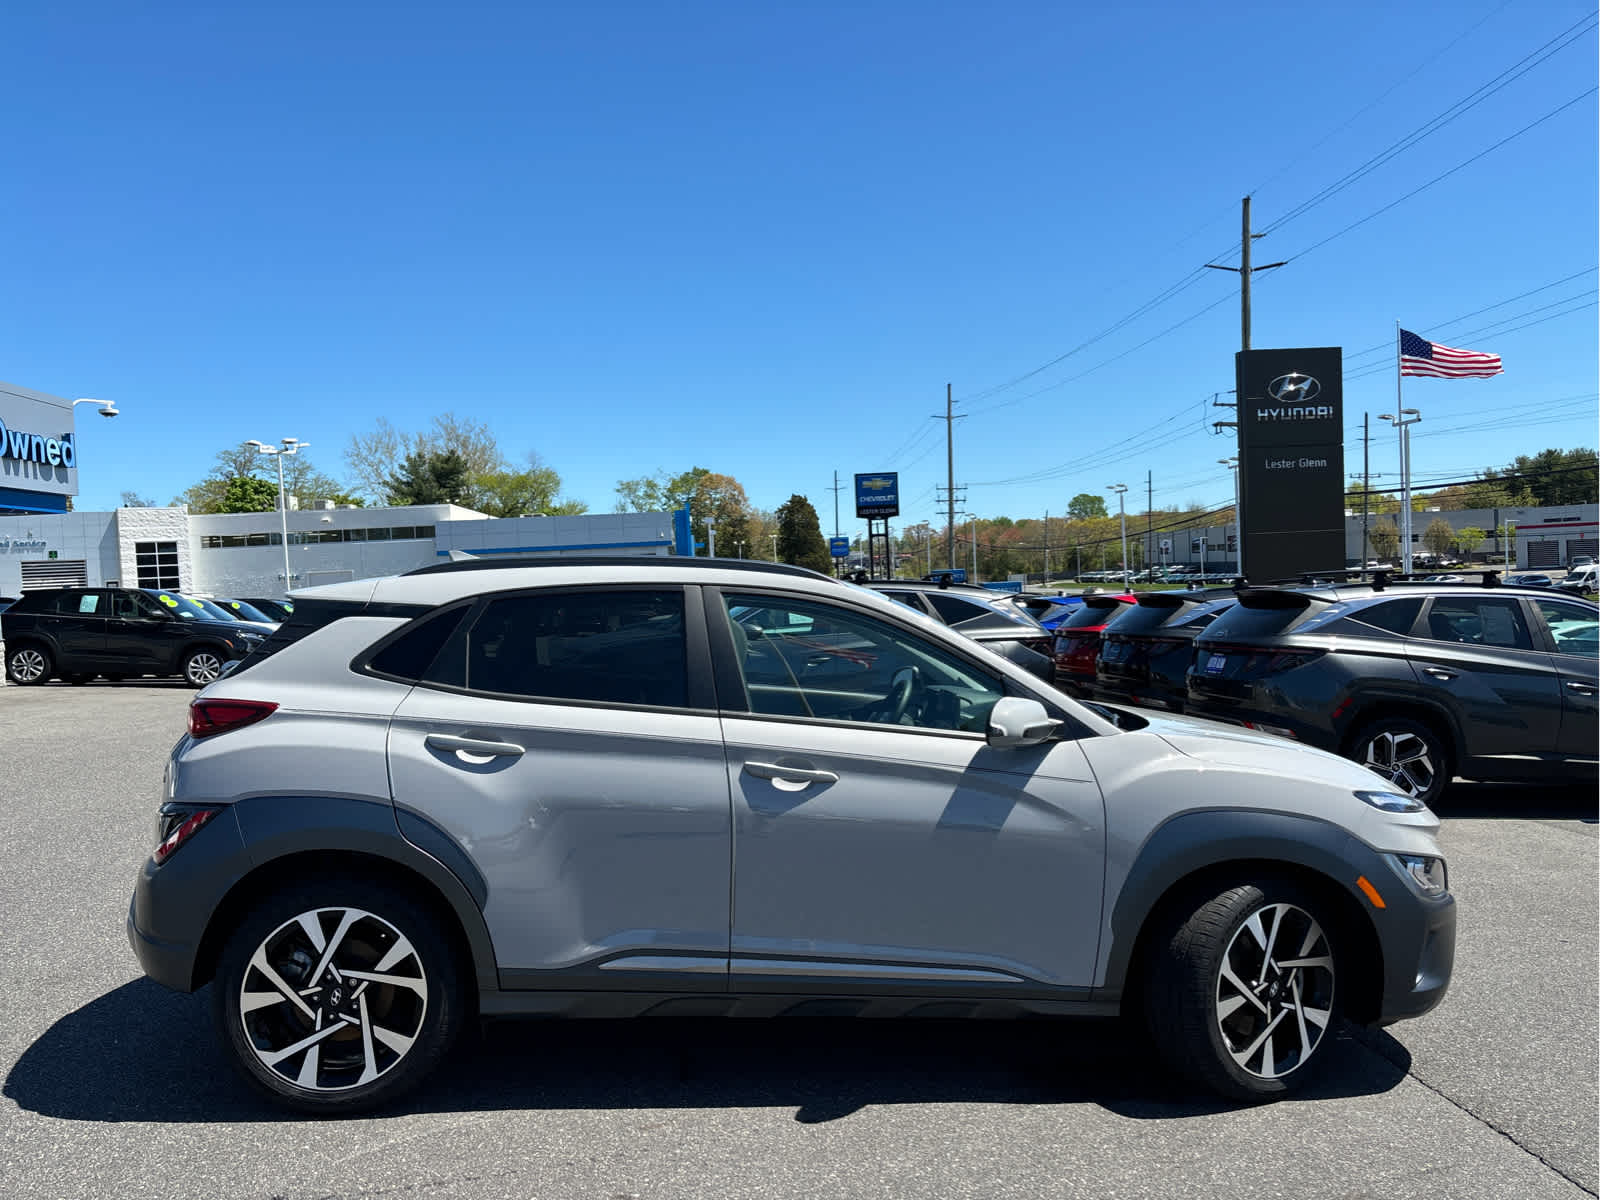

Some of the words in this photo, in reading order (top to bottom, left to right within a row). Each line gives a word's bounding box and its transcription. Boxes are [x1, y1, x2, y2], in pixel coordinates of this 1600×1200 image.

[1257, 406, 1334, 420] HYUNDAI
[1265, 459, 1296, 469] Lester
[1299, 458, 1327, 468] Glenn
